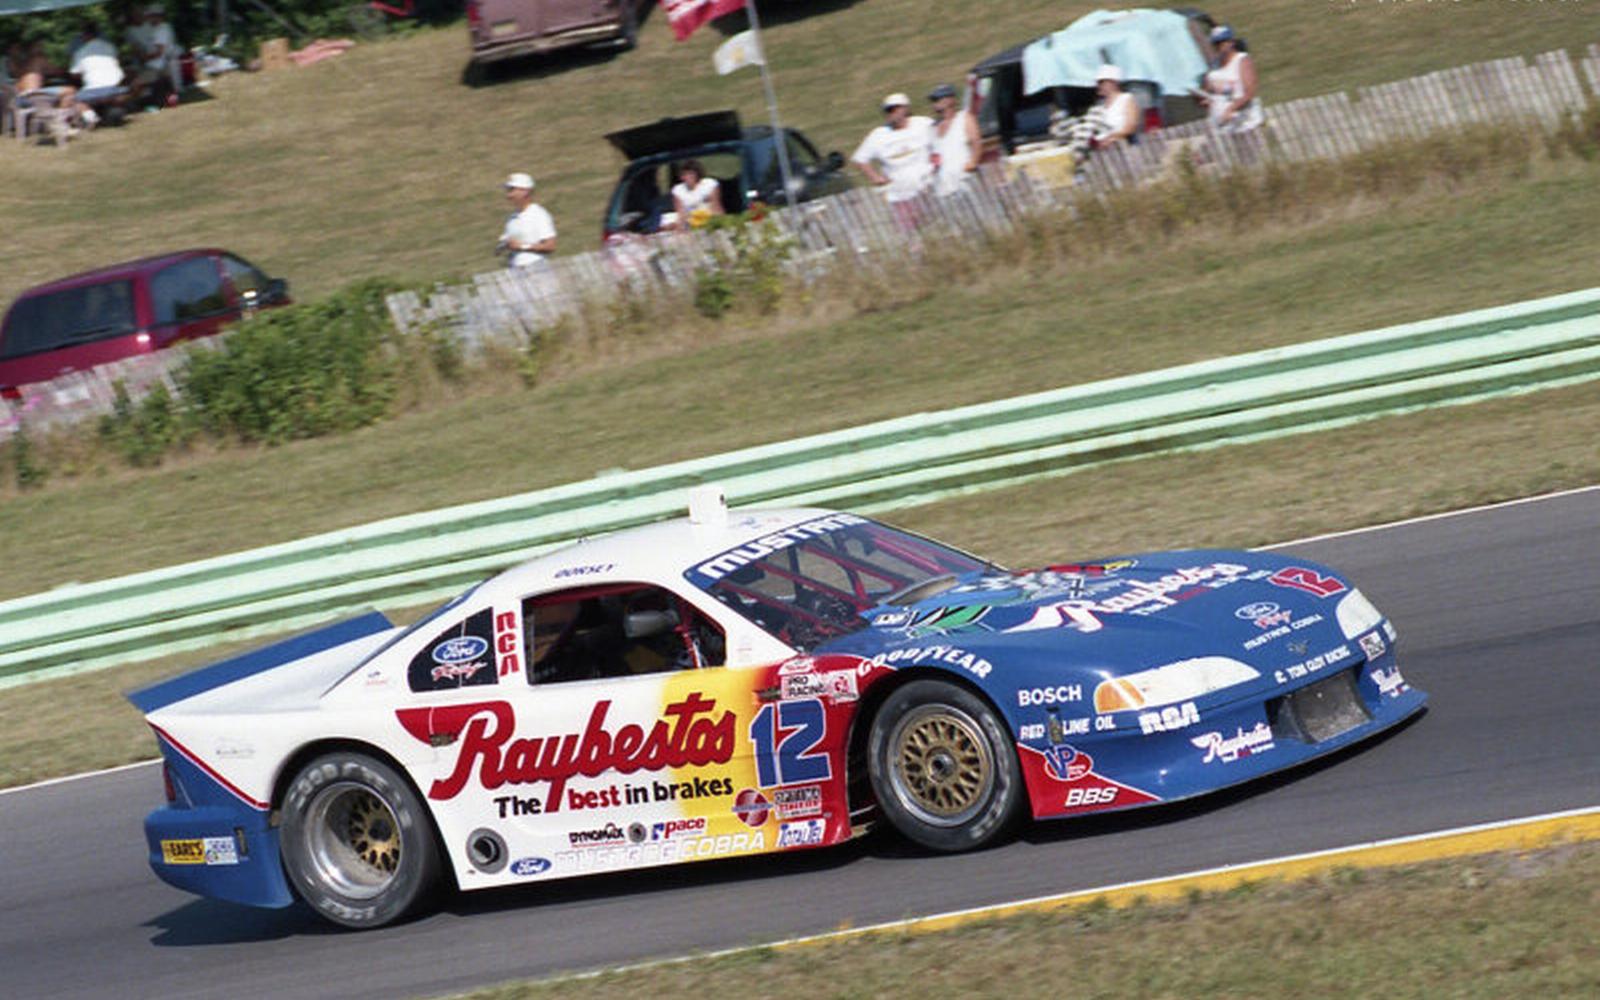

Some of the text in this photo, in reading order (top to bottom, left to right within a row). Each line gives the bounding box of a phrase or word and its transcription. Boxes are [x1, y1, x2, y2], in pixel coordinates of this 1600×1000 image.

[437, 638, 485, 662] Ford
[857, 645, 993, 680] GOODYEAR
[1018, 684, 1083, 707] BOSCH
[1020, 716, 1117, 740] RED LINE OIL
[394, 691, 737, 813] Raybestos
[748, 699, 832, 790] 12
[493, 776, 734, 819] The best in brakes
[1064, 787, 1119, 807] BBS
[663, 818, 706, 839] pace
[677, 831, 765, 862] COBRA
[513, 858, 548, 875] Ford
